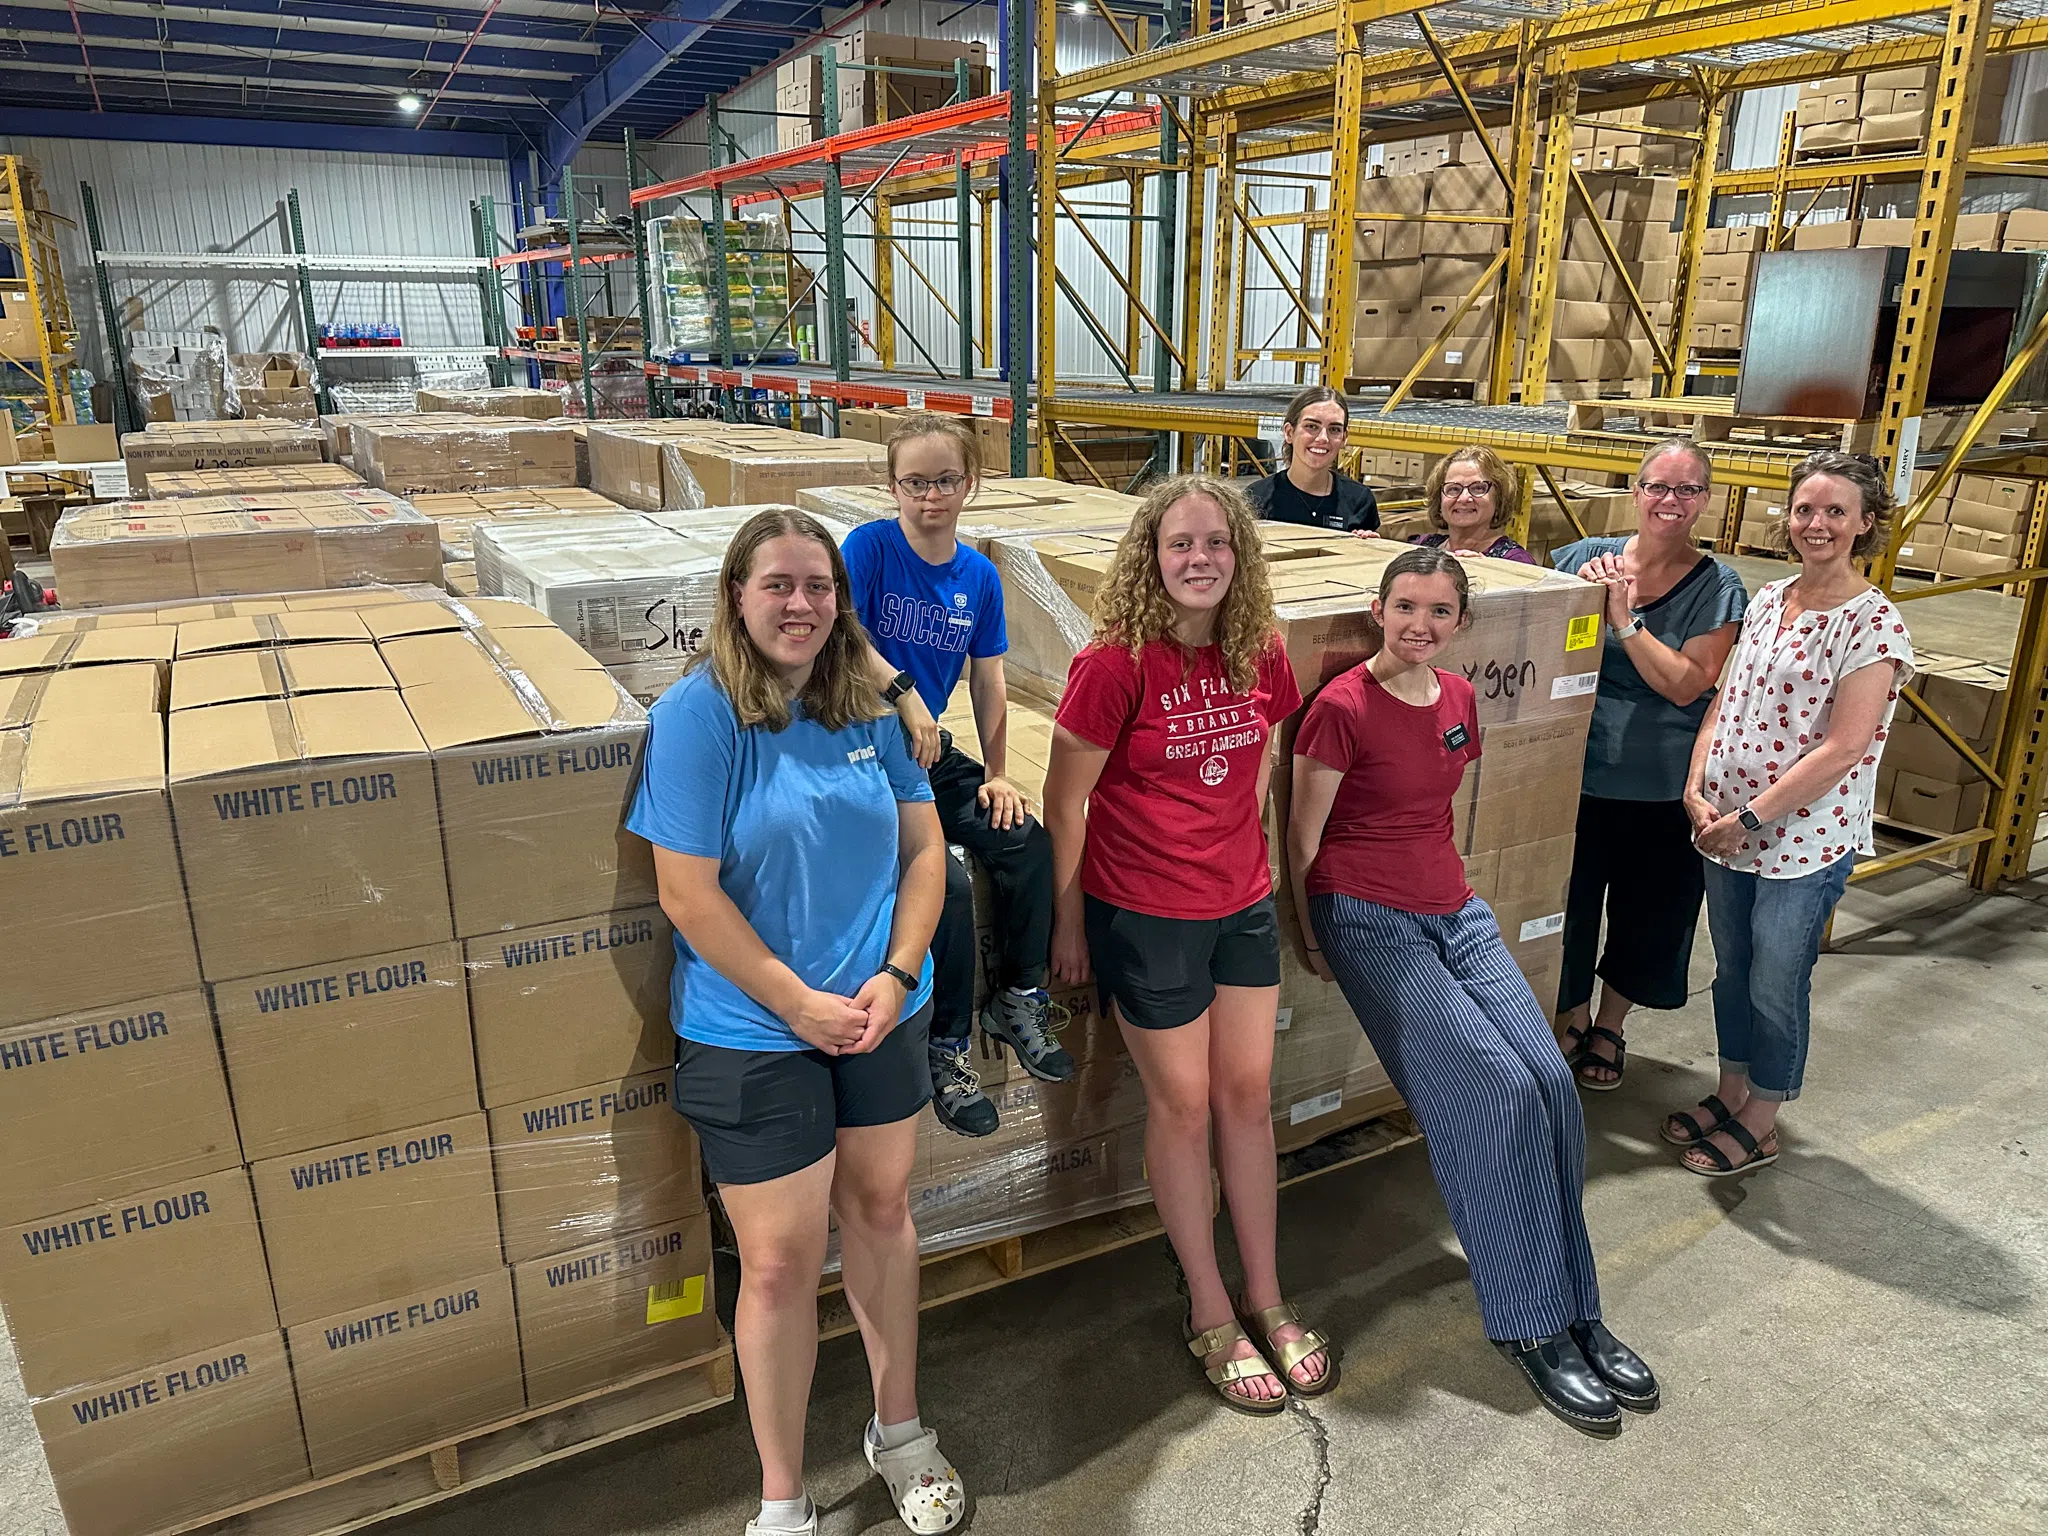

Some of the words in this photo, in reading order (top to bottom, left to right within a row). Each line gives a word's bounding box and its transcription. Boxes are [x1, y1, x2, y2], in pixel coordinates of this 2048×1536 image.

[127, 451, 142, 459] NON
[143, 450, 155, 458] FAT
[157, 450, 175, 458] MILK
[177, 450, 191, 458] NON
[192, 449, 205, 457] FAT
[206, 448, 223, 457] MILK
[227, 448, 241, 456] NON
[242, 447, 254, 456] FAT
[255, 446, 272, 455] MILK
[275, 446, 288, 454] NON
[289, 445, 301, 453] FAT
[302, 444, 318, 452] MILK
[1901, 448, 1910, 478] DAIRY
[645, 599, 703, 651] She
[877, 593, 974, 653] SOCCER
[1160, 683, 1191, 711] SIX
[1200, 677, 1250, 698] FLA
[1463, 658, 1536, 700] ygen
[1187, 711, 1240, 732] BRAND
[472, 750, 553, 786] WHITE
[557, 742, 632, 775] FLOUR
[1166, 740, 1207, 760] GREAT
[1212, 728, 1261, 753] AMERICA
[214, 784, 305, 821] WHITE
[312, 773, 397, 810] FLOUR
[25, 813, 126, 854] FLOUR
[502, 934, 577, 969] WHITE
[582, 919, 653, 954] FLOUR
[254, 977, 340, 1014] WHITE
[346, 960, 428, 999] FLOUR
[1048, 995, 1092, 1021] ALSA
[75, 1011, 169, 1054] FLOUR
[522, 1098, 595, 1135] WHITE
[600, 1082, 668, 1117] FLOUR
[992, 1085, 1038, 1111] ALSA
[290, 1152, 371, 1192] WHITE
[376, 1133, 454, 1173] FLOUR
[1038, 1147, 1093, 1177] SALSA
[22, 1213, 115, 1258] WHITE
[121, 1190, 211, 1232] FLOUR
[545, 1252, 614, 1288] WHITE
[618, 1231, 683, 1267] FLOUR
[324, 1310, 402, 1351] WHITE
[406, 1289, 480, 1328] FLOUR
[71, 1380, 159, 1426] WHITE
[166, 1353, 249, 1397] FLOUR
